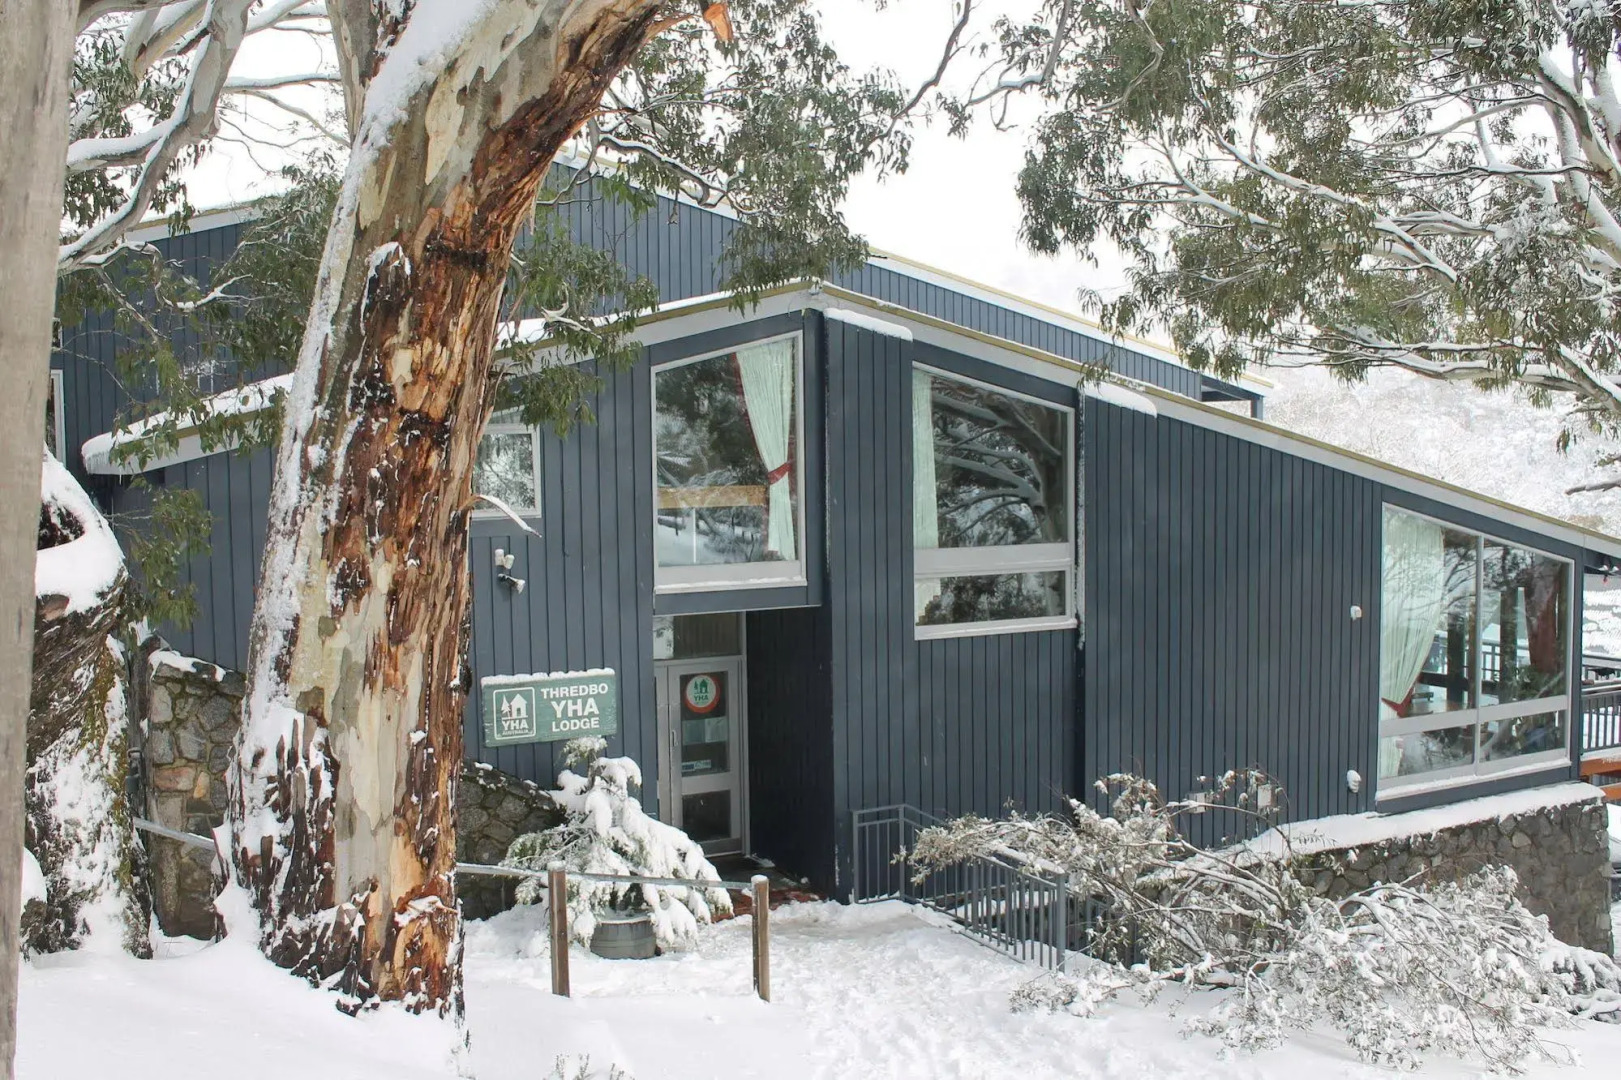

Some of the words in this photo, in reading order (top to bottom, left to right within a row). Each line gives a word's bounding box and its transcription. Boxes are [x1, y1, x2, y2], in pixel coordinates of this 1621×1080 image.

[541, 683, 608, 699] THREDBO
[551, 697, 599, 718] YHA
[502, 719, 529, 730] YHA
[552, 717, 599, 732] LODGE
